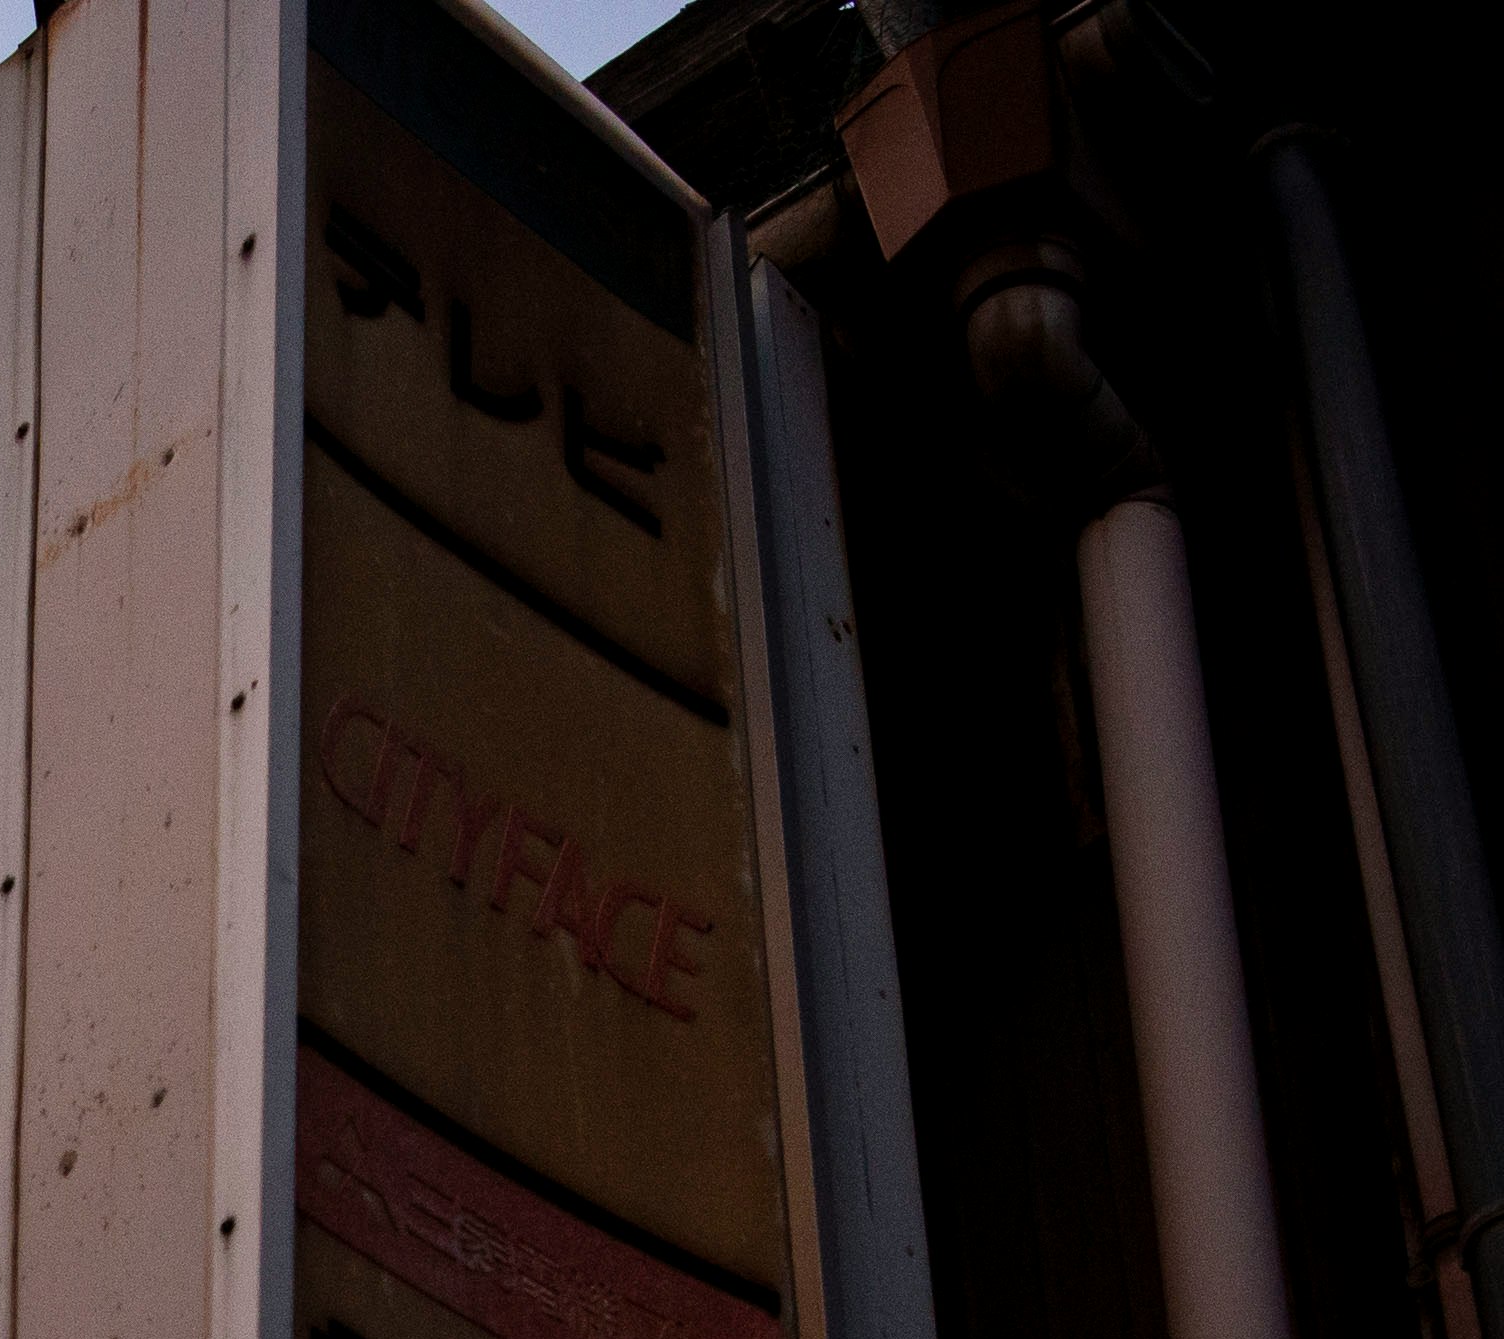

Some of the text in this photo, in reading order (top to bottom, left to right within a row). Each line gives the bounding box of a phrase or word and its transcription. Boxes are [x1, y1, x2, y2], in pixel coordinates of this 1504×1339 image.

[325, 200, 666, 538] テレビ
[318, 696, 714, 1022] CITYFACE
